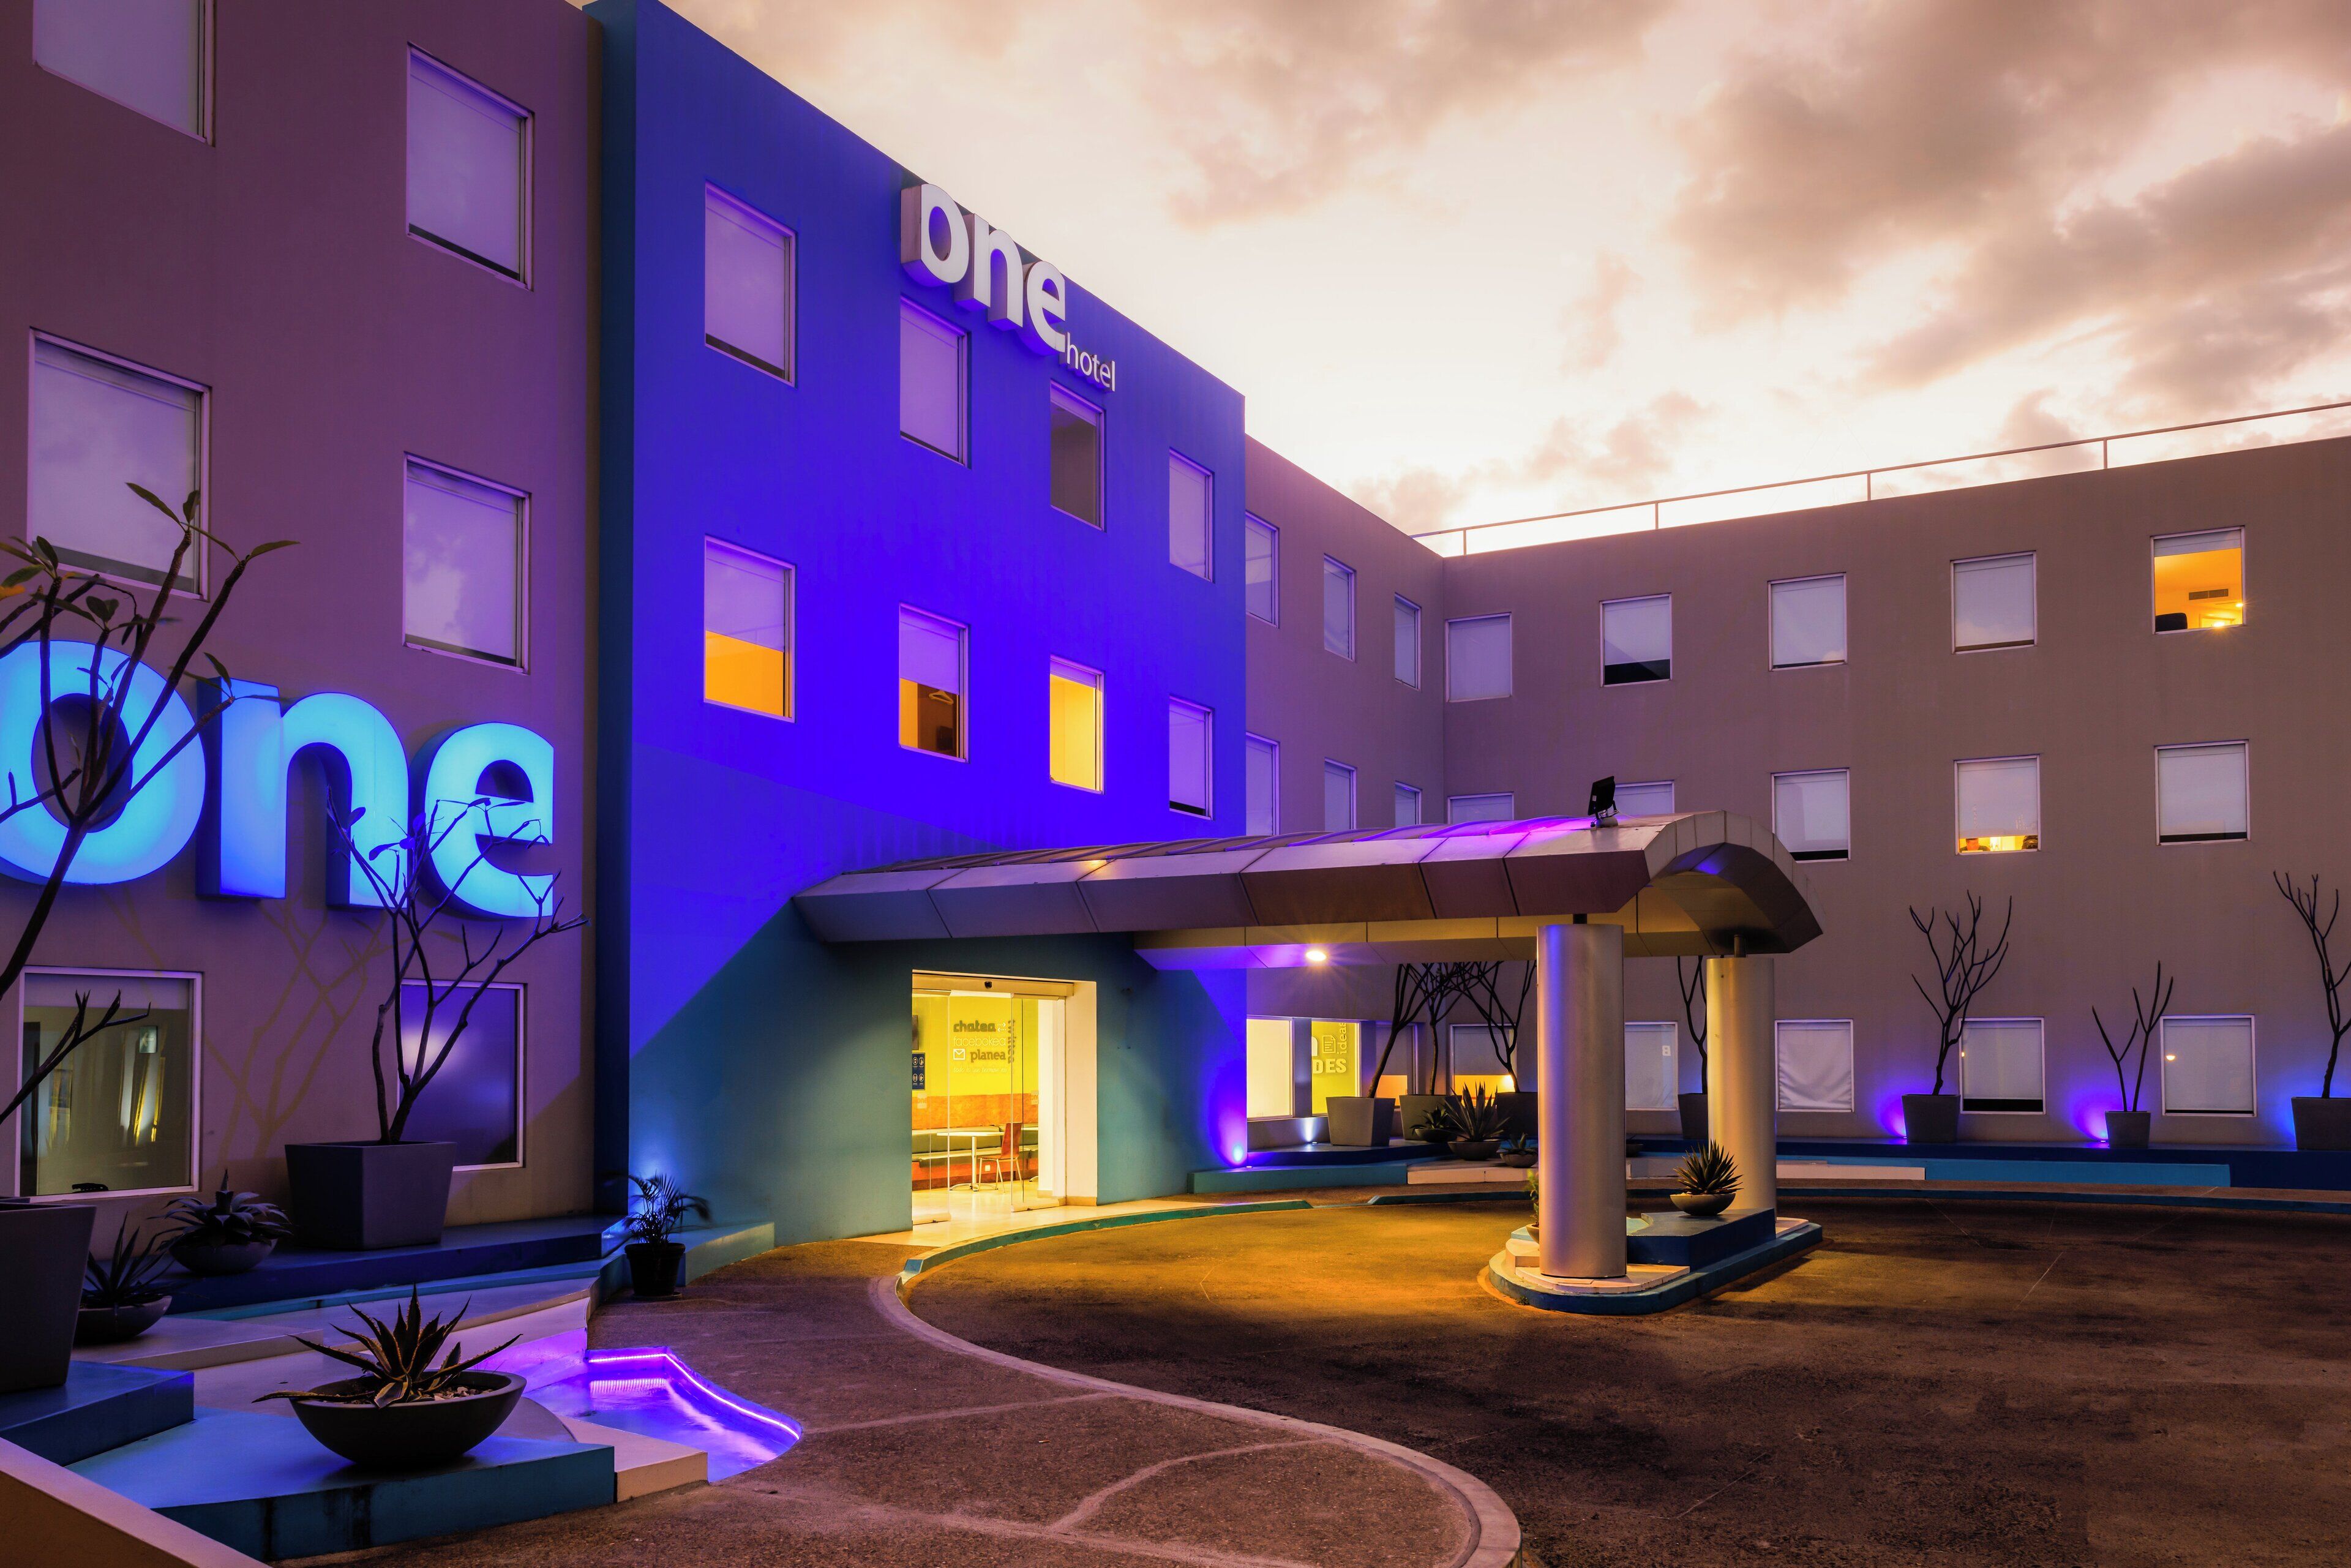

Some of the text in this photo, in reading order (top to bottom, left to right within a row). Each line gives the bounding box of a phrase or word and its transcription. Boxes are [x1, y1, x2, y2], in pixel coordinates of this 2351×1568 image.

[901, 183, 1065, 355] one
[1065, 332, 1116, 392] hotel
[0, 640, 555, 918] one
[953, 1020, 996, 1032] chatea
[970, 1049, 1007, 1063] planea
